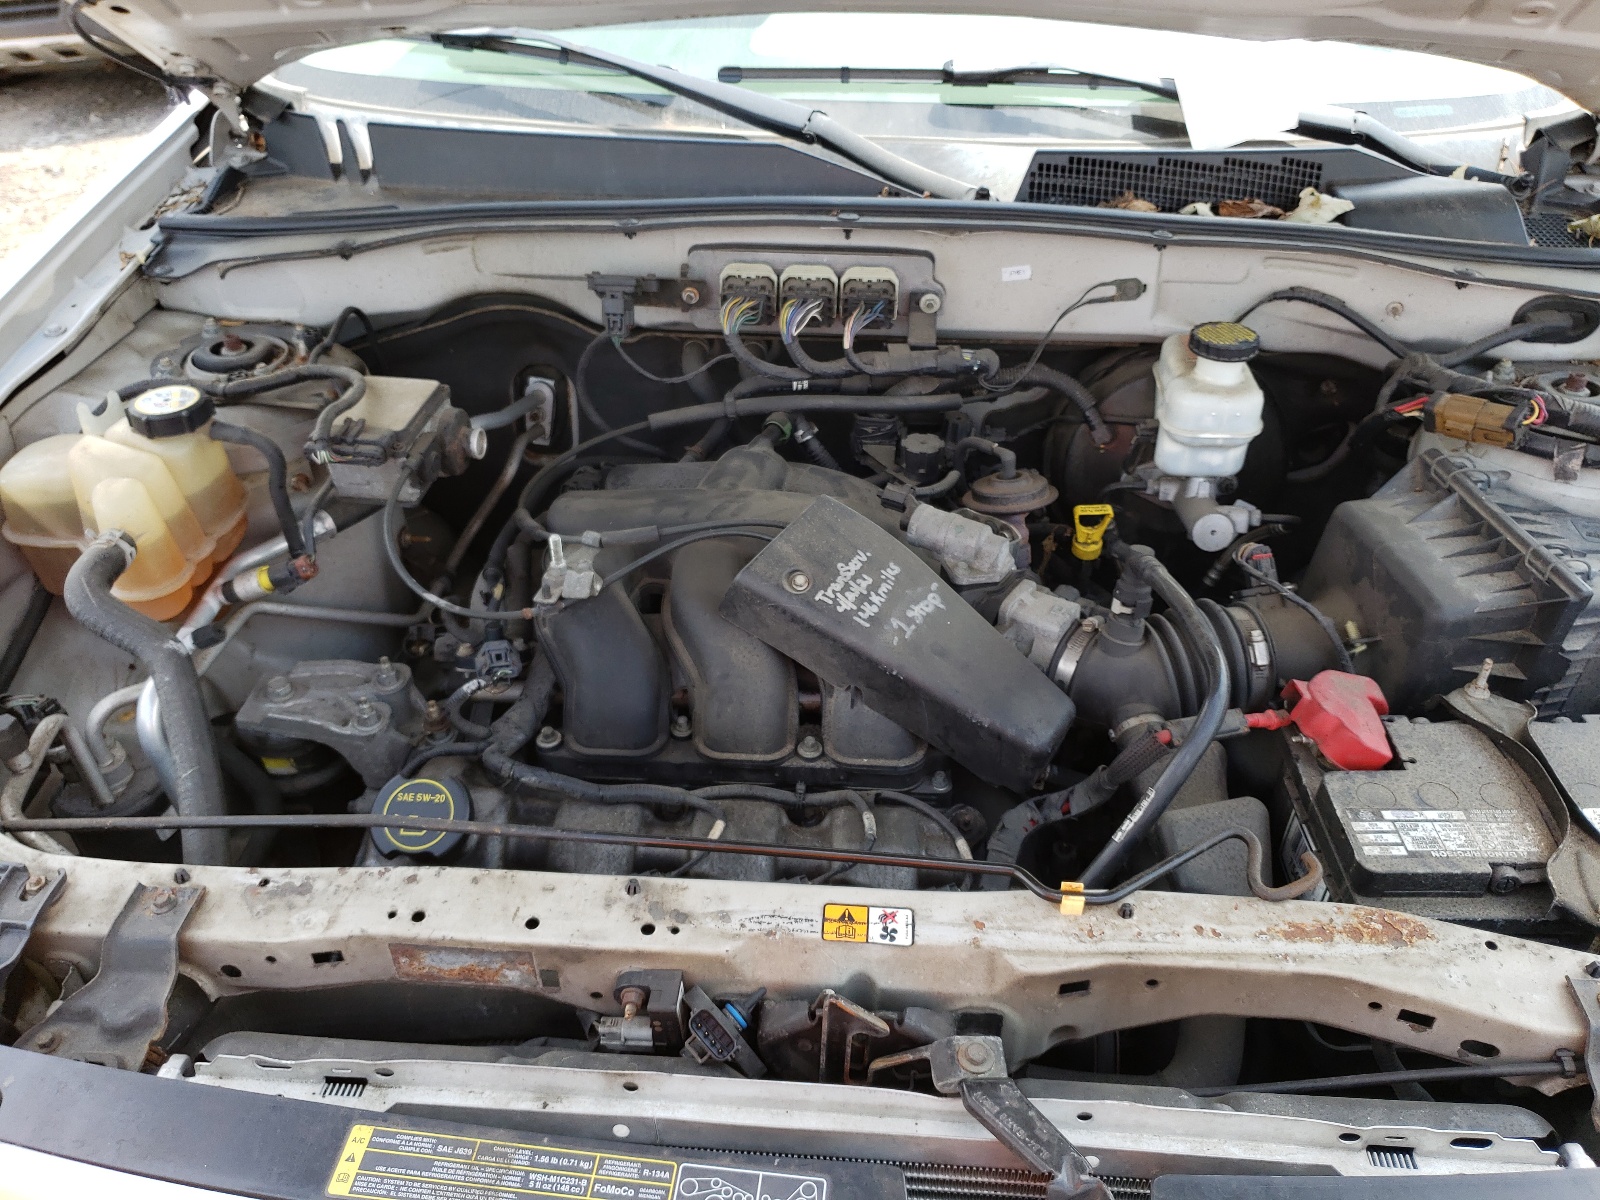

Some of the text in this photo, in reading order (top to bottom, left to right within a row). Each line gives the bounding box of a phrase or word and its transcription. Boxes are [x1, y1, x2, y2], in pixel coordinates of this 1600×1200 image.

[397, 792, 446, 803] SAE 5W-20
[352, 1136, 365, 1144] A/C
[437, 1144, 472, 1155] SAE J639
[534, 1154, 549, 1162] 1.56
[559, 1157, 578, 1167] (0.71
[579, 1160, 593, 1169] kg)
[528, 1172, 588, 1186] WSH-M1C231-B
[643, 1169, 670, 1178] R-134A
[552, 1183, 570, 1192] (148
[570, 1184, 585, 1194] cc)
[593, 1183, 635, 1196] FoMoCo
